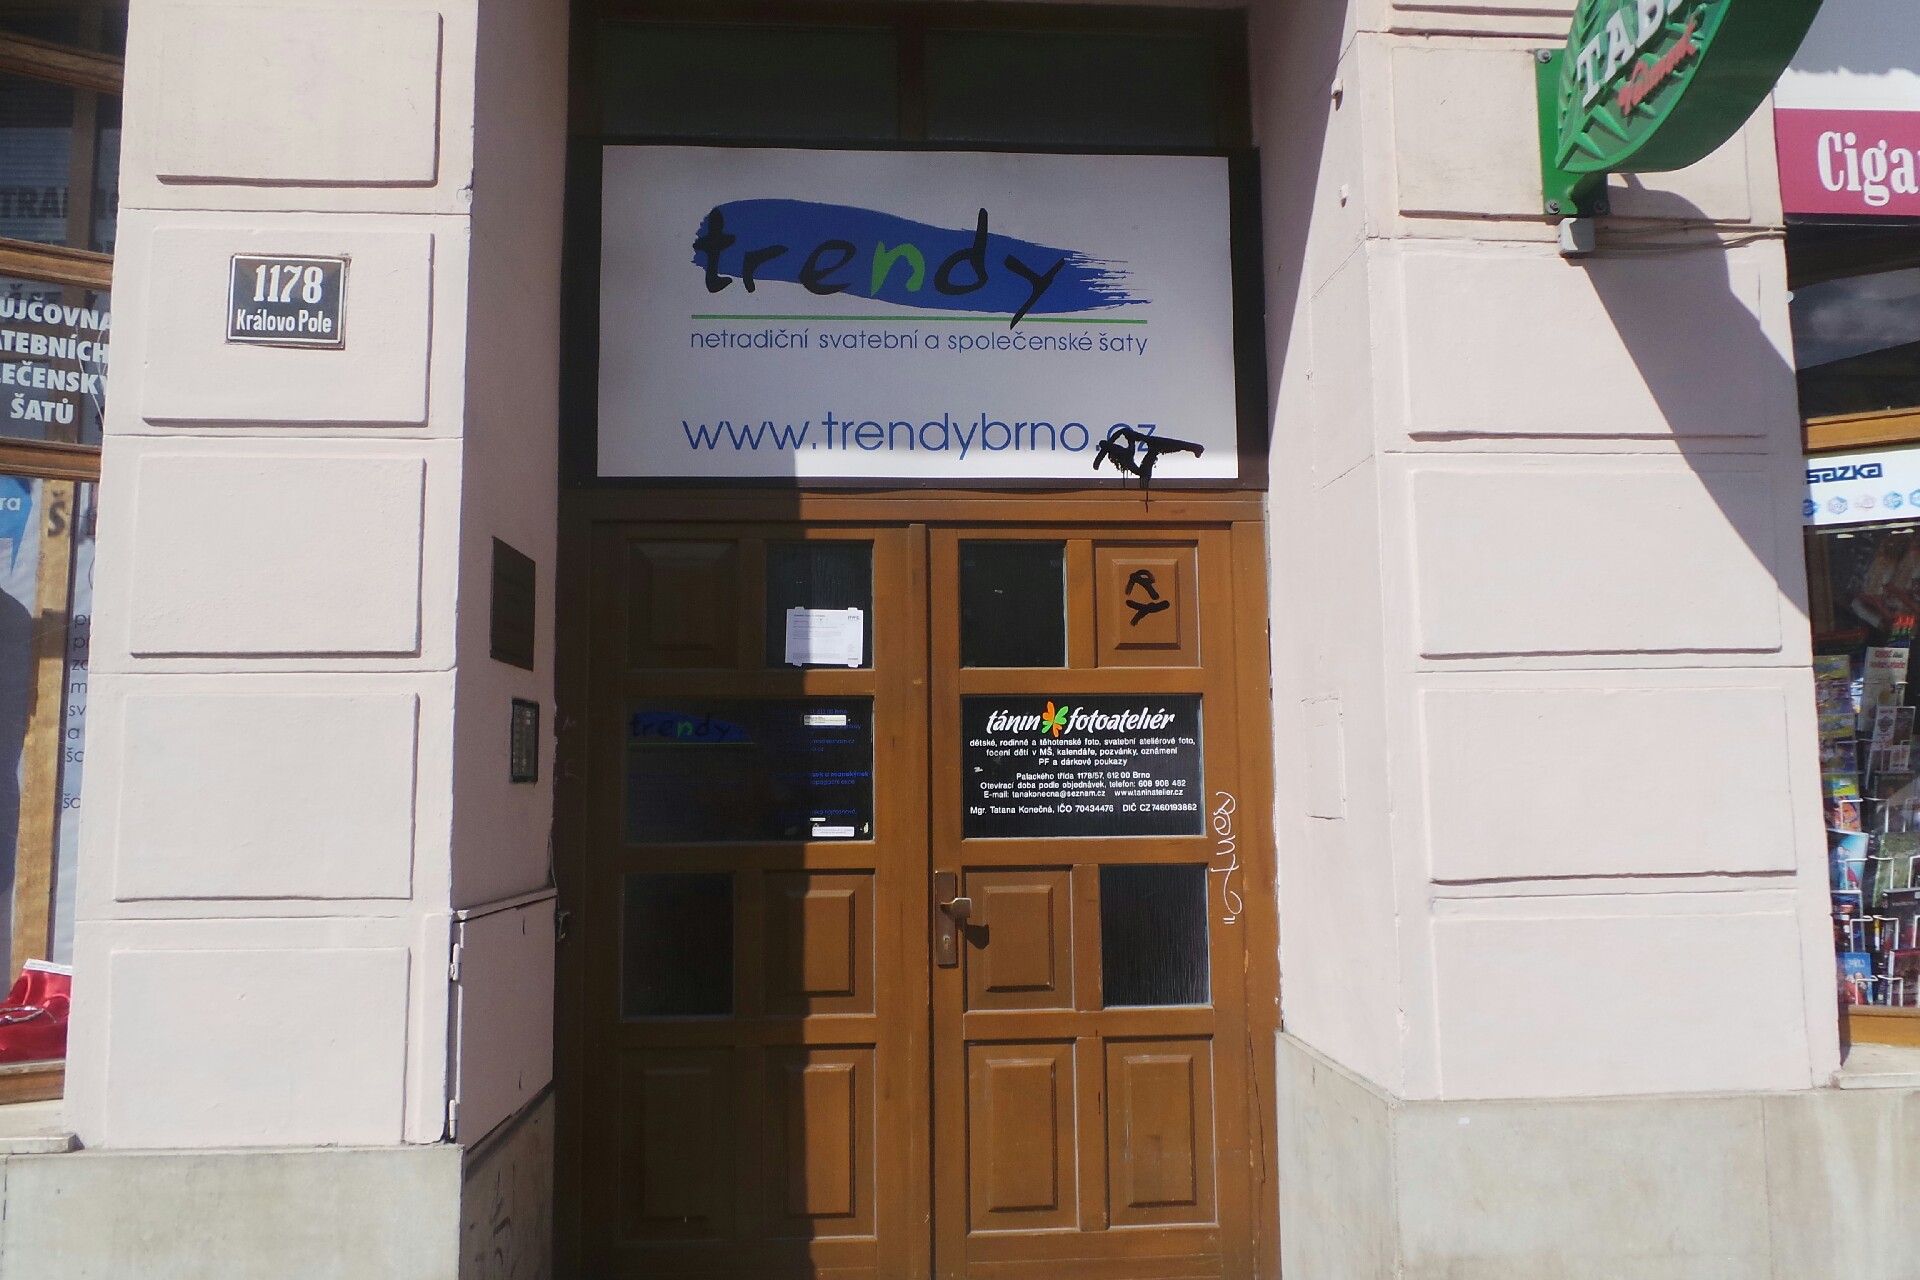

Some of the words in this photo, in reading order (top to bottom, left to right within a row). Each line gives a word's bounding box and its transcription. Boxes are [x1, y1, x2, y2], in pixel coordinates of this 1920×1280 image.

[1576, 0, 1683, 108] TAB
[1818, 131, 1920, 206] Ciga
[693, 207, 1066, 330] trendy
[253, 264, 323, 304] 1178
[236, 308, 296, 333] Královo
[298, 309, 332, 334] Pole
[0, 329, 110, 364] TEBNÍCH
[691, 328, 808, 350] netradiční
[819, 329, 918, 350] svatební
[925, 336, 940, 350] a
[947, 331, 1093, 354] společenské
[1099, 333, 1148, 356] šaty
[10, 392, 74, 424] ŠATŮ
[1063, 706, 1176, 734] fotoateliér
[969, 739, 998, 748] dětské,
[1000, 738, 1029, 747] rodinné
[1040, 738, 1082, 747] těhotenské
[1084, 738, 1102, 747] foto,
[1104, 737, 1137, 746] svatební
[1139, 736, 1176, 746] ateliérové
[1178, 736, 1196, 746] foto,
[1039, 746, 1055, 757] MŠ,
[1056, 747, 1098, 757] kalendáře,
[1099, 747, 1139, 757] pozvánky,
[1140, 747, 1178, 756] oznámení
[1038, 758, 1050, 766] PF
[1060, 757, 1092, 766] dárkové
[1094, 758, 1128, 767] poukazy
[1016, 772, 1055, 781] Palackého
[1057, 772, 1075, 780] třída
[1132, 771, 1152, 779] Brno
[1017, 781, 1037, 790] doba
[1038, 781, 1060, 791] podle
[1062, 780, 1107, 790] objednávek,
[1108, 780, 1136, 789] telefon:
[983, 790, 1010, 799] E-mail:
[1012, 789, 1106, 799] tanakonecna@seznam.cz
[1114, 788, 1184, 797] www.taninatelier.cz
[969, 806, 987, 816] Mgr.
[1018, 804, 1055, 814] Konečná,
[1057, 802, 1073, 813] IČO
[1122, 802, 1137, 812] DIČ
